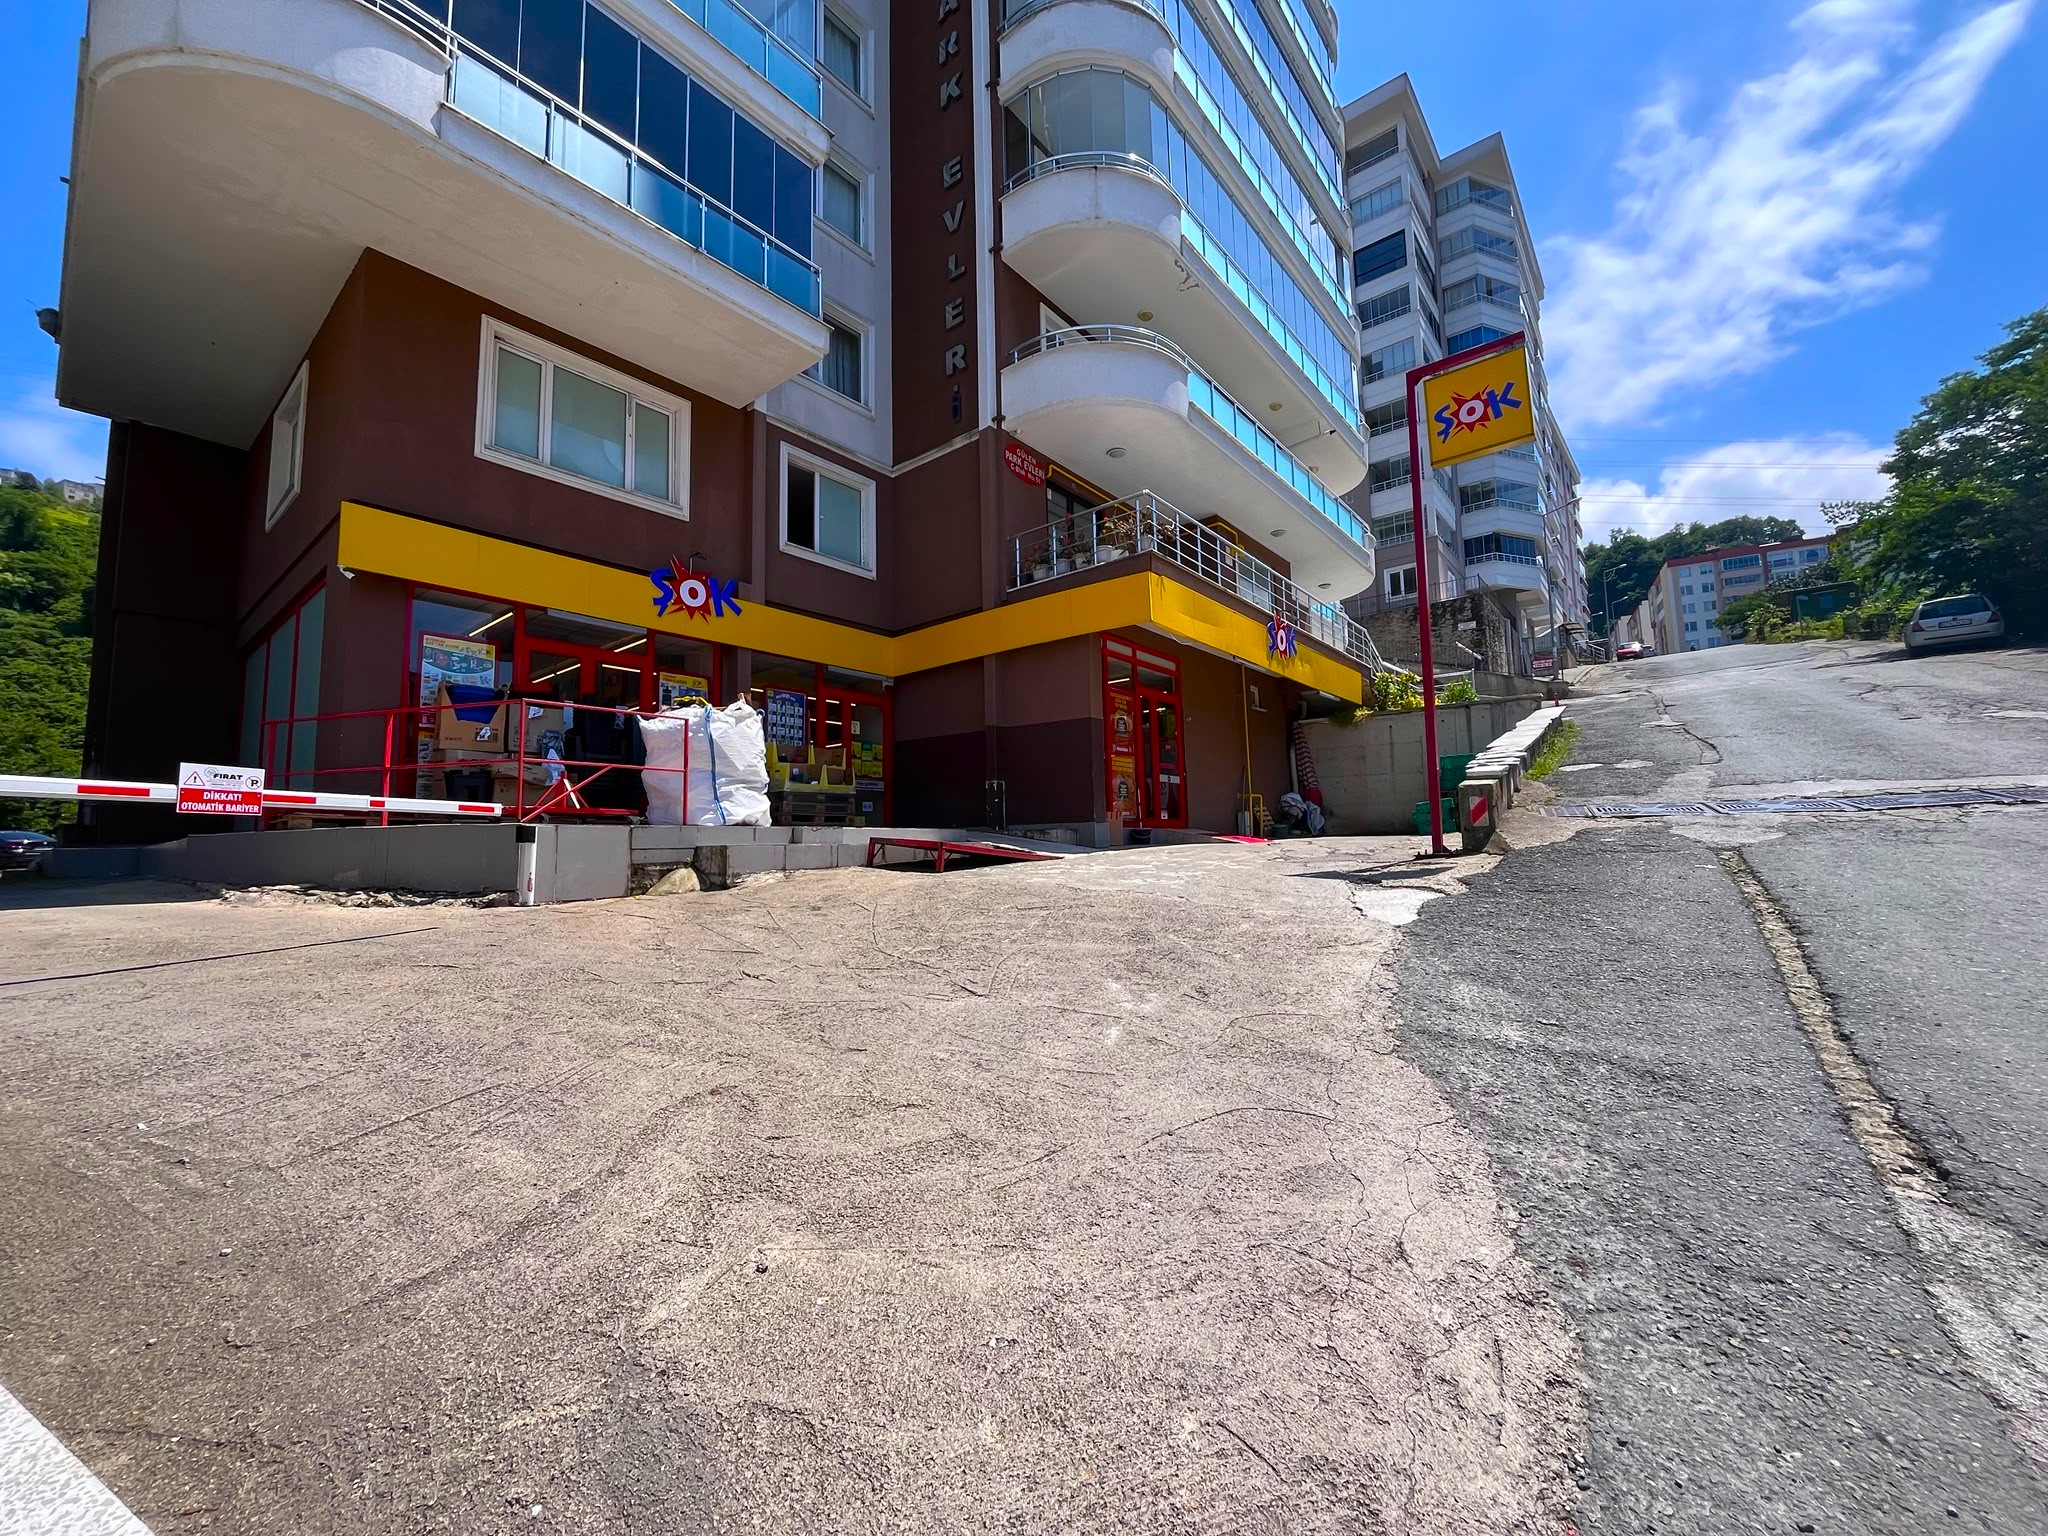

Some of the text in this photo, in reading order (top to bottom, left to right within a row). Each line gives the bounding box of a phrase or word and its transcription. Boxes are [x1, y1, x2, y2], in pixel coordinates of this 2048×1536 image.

[1433, 381, 1522, 444] ŞOK
[1006, 450, 1044, 478] PARK EVLERİ
[649, 567, 743, 618] ŞOK
[1266, 621, 1298, 660] ŞOK
[181, 801, 260, 813] OTOMATİK BARİYER
[203, 791, 243, 802] DİKKAT!
